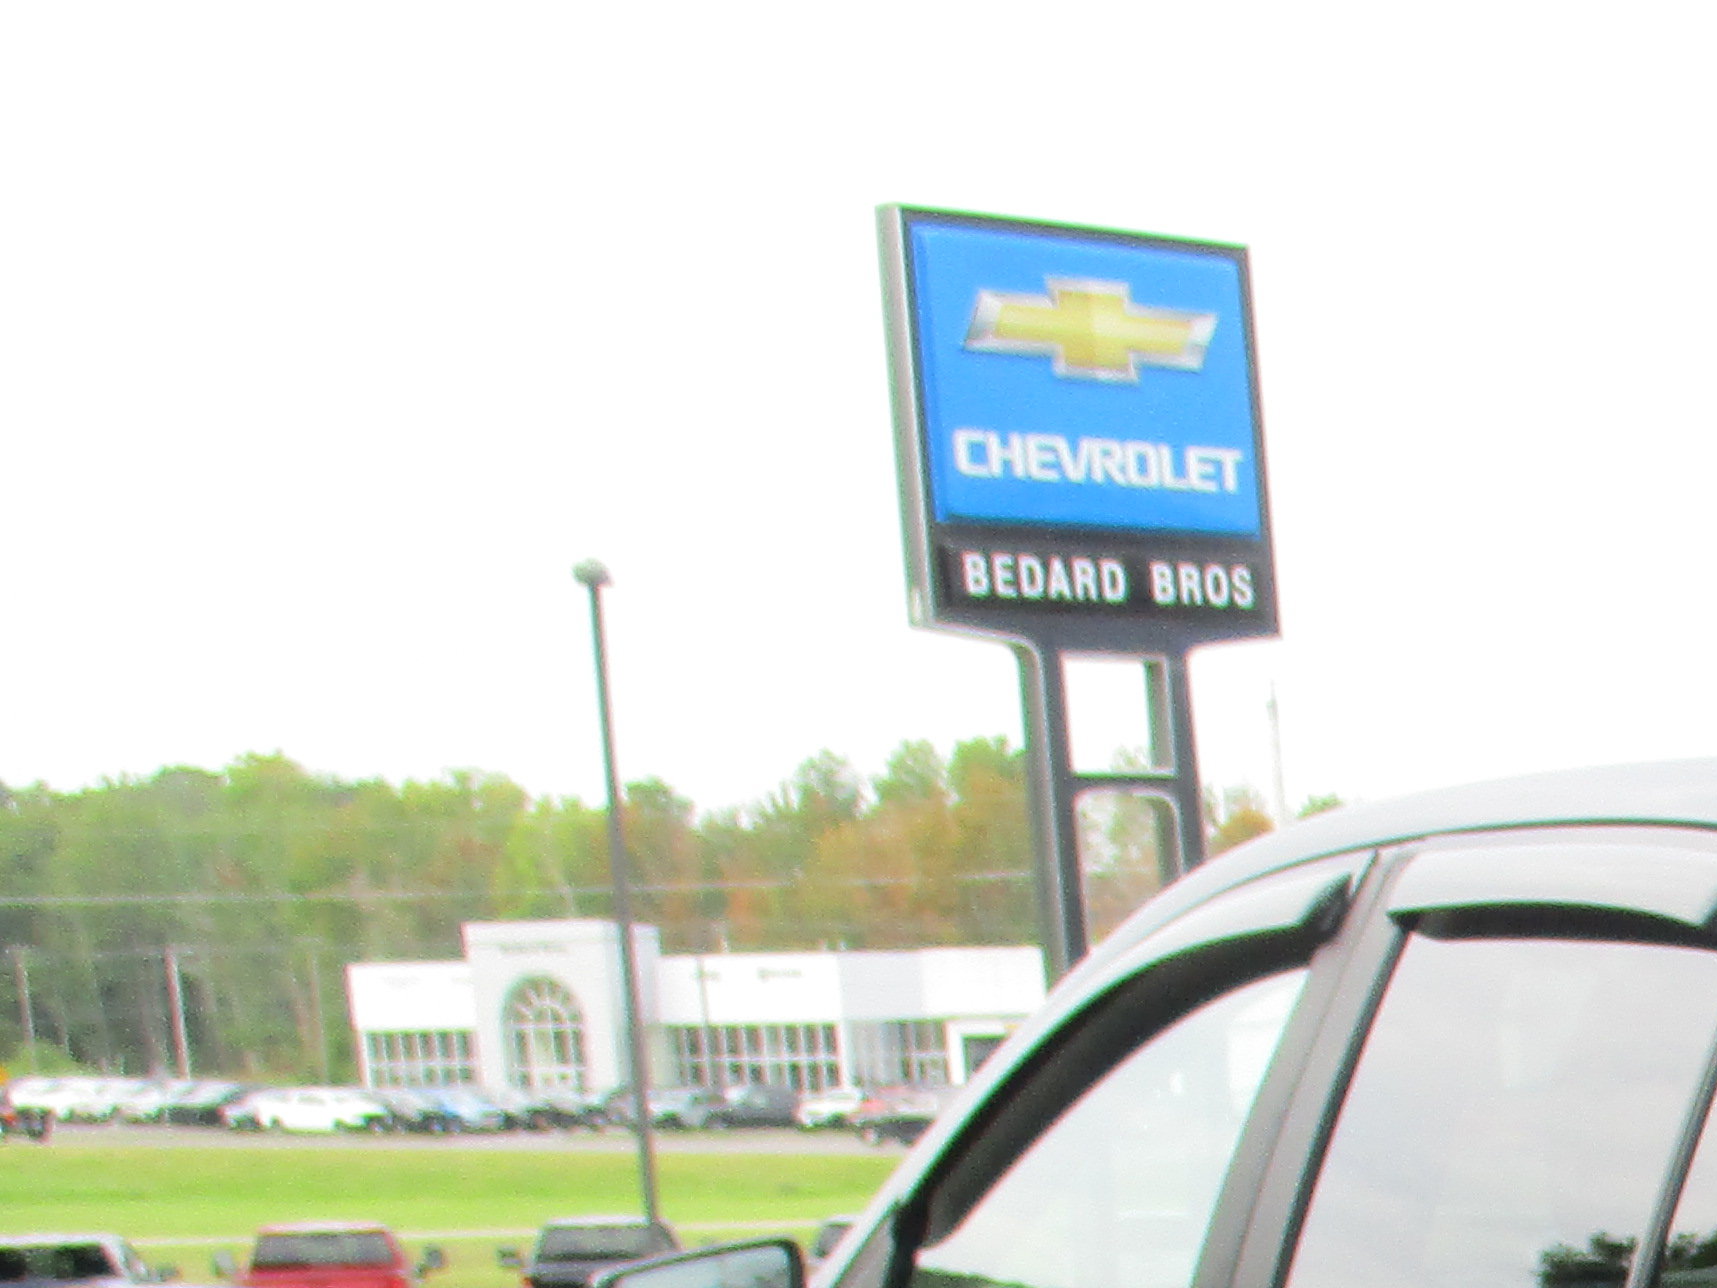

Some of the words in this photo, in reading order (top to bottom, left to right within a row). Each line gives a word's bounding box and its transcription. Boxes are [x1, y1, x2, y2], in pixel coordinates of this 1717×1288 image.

[952, 428, 1243, 493] CHEVROLET
[962, 551, 1128, 605] BEDARD
[1149, 560, 1256, 610] BROS
